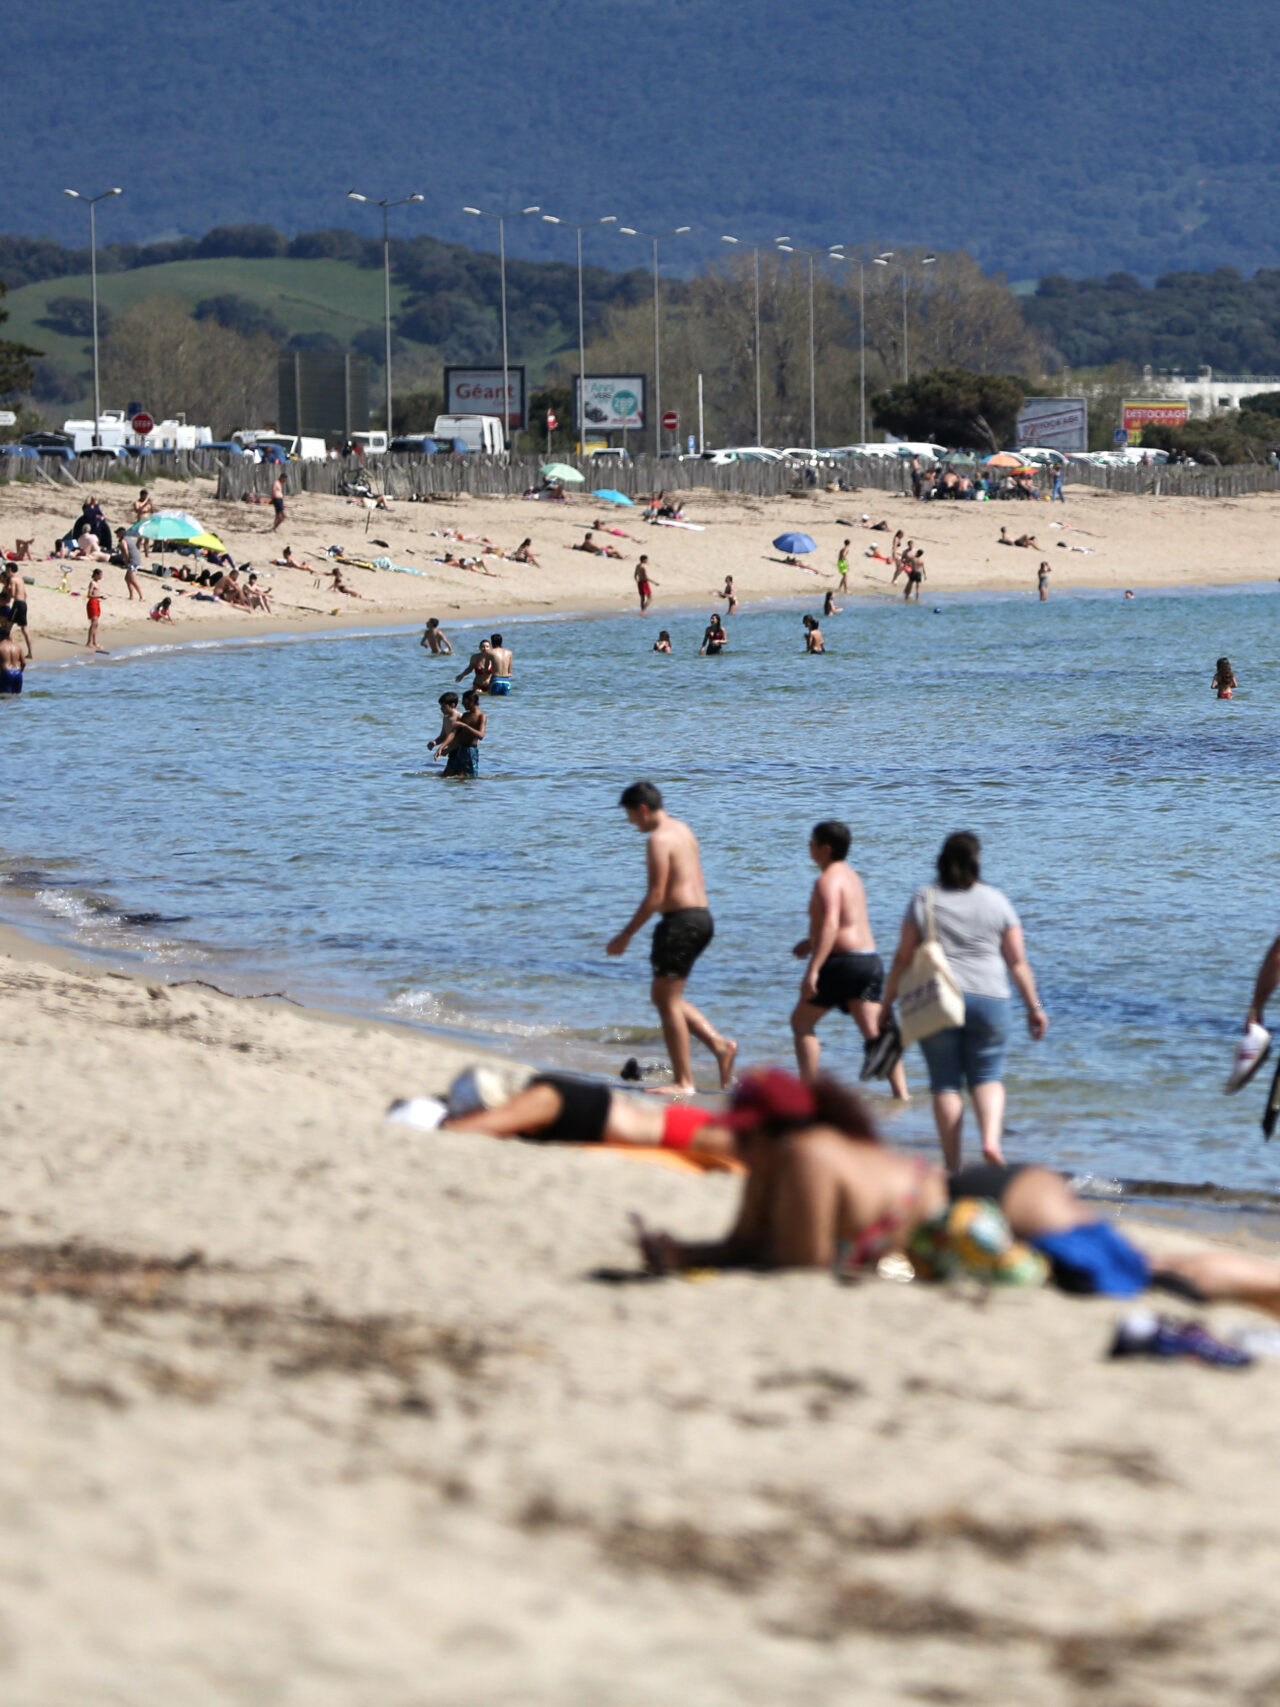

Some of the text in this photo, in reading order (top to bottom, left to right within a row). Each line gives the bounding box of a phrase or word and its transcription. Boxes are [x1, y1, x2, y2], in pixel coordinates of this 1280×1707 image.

[456, 382, 515, 400] Géant
[1126, 409, 1188, 419] DESTOCKAGE
[134, 420, 151, 428] STOP
